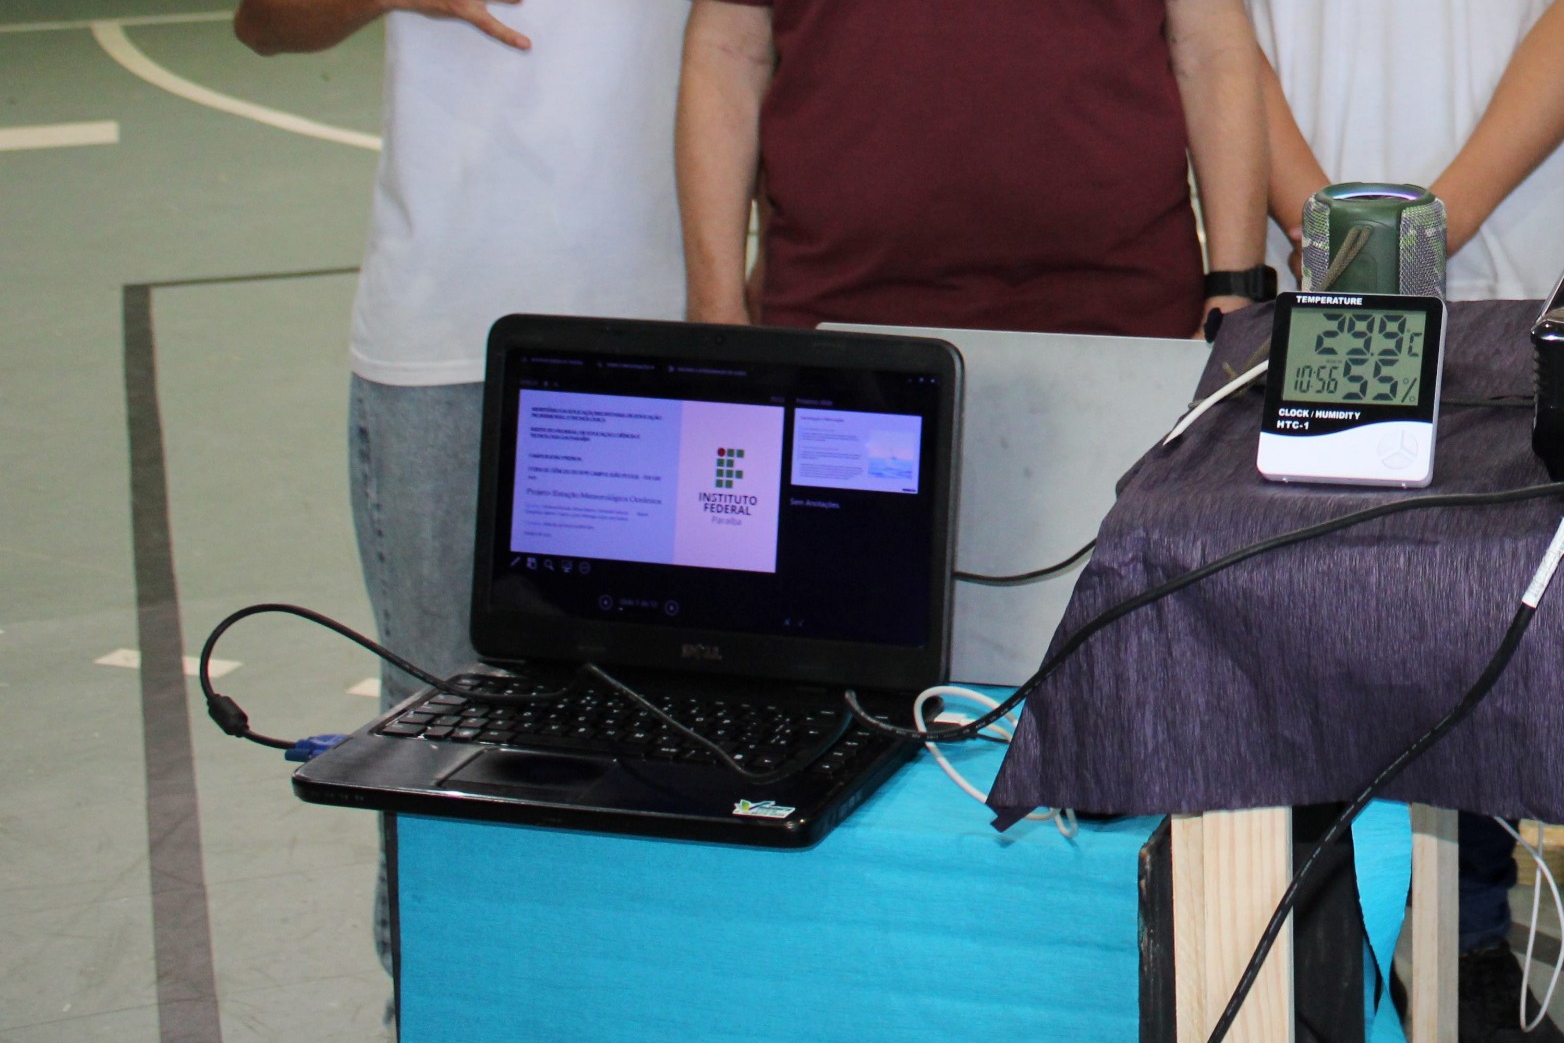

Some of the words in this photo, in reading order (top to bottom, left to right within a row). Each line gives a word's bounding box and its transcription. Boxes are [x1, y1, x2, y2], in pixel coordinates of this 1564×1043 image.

[1296, 295, 1363, 306] TEMPERATURE
[1294, 365, 1339, 394] 10:56
[1278, 408, 1310, 419] CLOCK
[1315, 410, 1361, 421] HUMIDITY
[1276, 420, 1310, 430] HTC-1
[699, 492, 758, 506] INSTITUTO
[704, 502, 752, 516] FEDERAL
